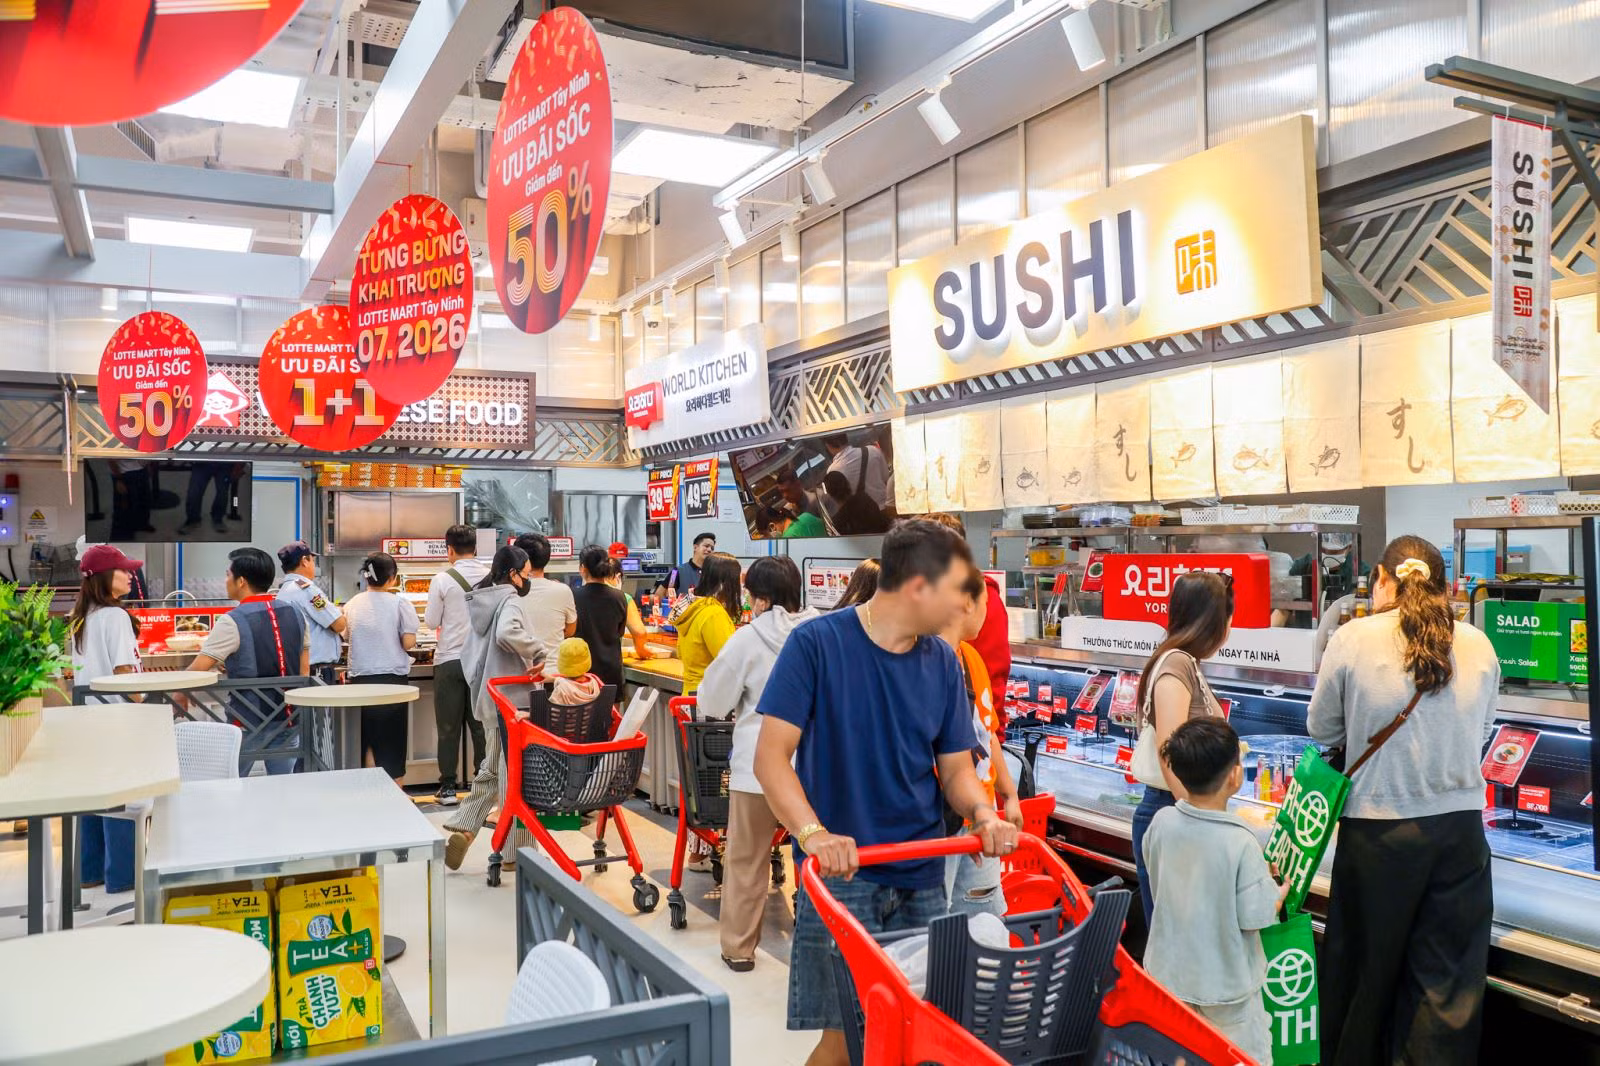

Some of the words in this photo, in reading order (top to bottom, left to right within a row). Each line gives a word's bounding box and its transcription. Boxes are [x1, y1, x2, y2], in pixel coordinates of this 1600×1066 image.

[504, 114, 528, 144] LOTTE
[527, 96, 551, 128] MART
[552, 88, 568, 111] Tây
[569, 69, 590, 100] Ninh
[502, 146, 524, 186] ƯU
[525, 126, 552, 172] ĐÃI
[556, 100, 591, 152] SỐC
[525, 168, 546, 197] Giảm
[546, 160, 562, 186] đến
[1513, 151, 1534, 280] SUSHI
[360, 243, 409, 276] TƯNG
[412, 229, 466, 265] BỪNG
[358, 278, 394, 304] KHAI
[397, 262, 465, 296] TRƯƠNG
[934, 208, 1136, 352] SUSHI
[358, 309, 388, 326] LOTTE
[390, 303, 419, 321] MART
[421, 300, 438, 317] Tây
[440, 295, 464, 310] Ninh
[114, 350, 136, 360] LOTTE
[137, 348, 158, 358] MART
[159, 348, 172, 357] Tây
[173, 346, 191, 356] Ninh
[282, 344, 313, 352] LOTTE
[314, 344, 343, 352] MART
[358, 313, 466, 364] 07.2026
[113, 364, 133, 380] ƯU
[136, 360, 159, 378] ĐÃI
[162, 358, 191, 376] SỐC
[281, 358, 309, 373] ƯU
[312, 356, 345, 373] ĐÃI
[661, 369, 696, 398] WORLD
[699, 352, 747, 386] KITCHEN
[136, 380, 154, 390] Giảm
[154, 378, 168, 388] đến
[294, 378, 384, 426] 1+1
[119, 384, 192, 438] 50%
[450, 402, 522, 426] FOOD
[1113, 424, 1137, 482] すし
[1386, 398, 1426, 474] すし
[1497, 614, 1540, 628] SALAD
[1082, 637, 1112, 648] THƯỞNG
[1113, 638, 1132, 649] THỨC
[1134, 639, 1151, 650] MÓN
[1219, 649, 1242, 659] NGAY
[1244, 650, 1258, 662] TẠI
[1260, 650, 1280, 662] NHÀ
[1518, 659, 1538, 667] Salad
[250, 920, 266, 942] MỚ
[296, 997, 308, 1018] TRÀ
[306, 976, 328, 1028] CHANH
[287, 1025, 300, 1048] MỚI
